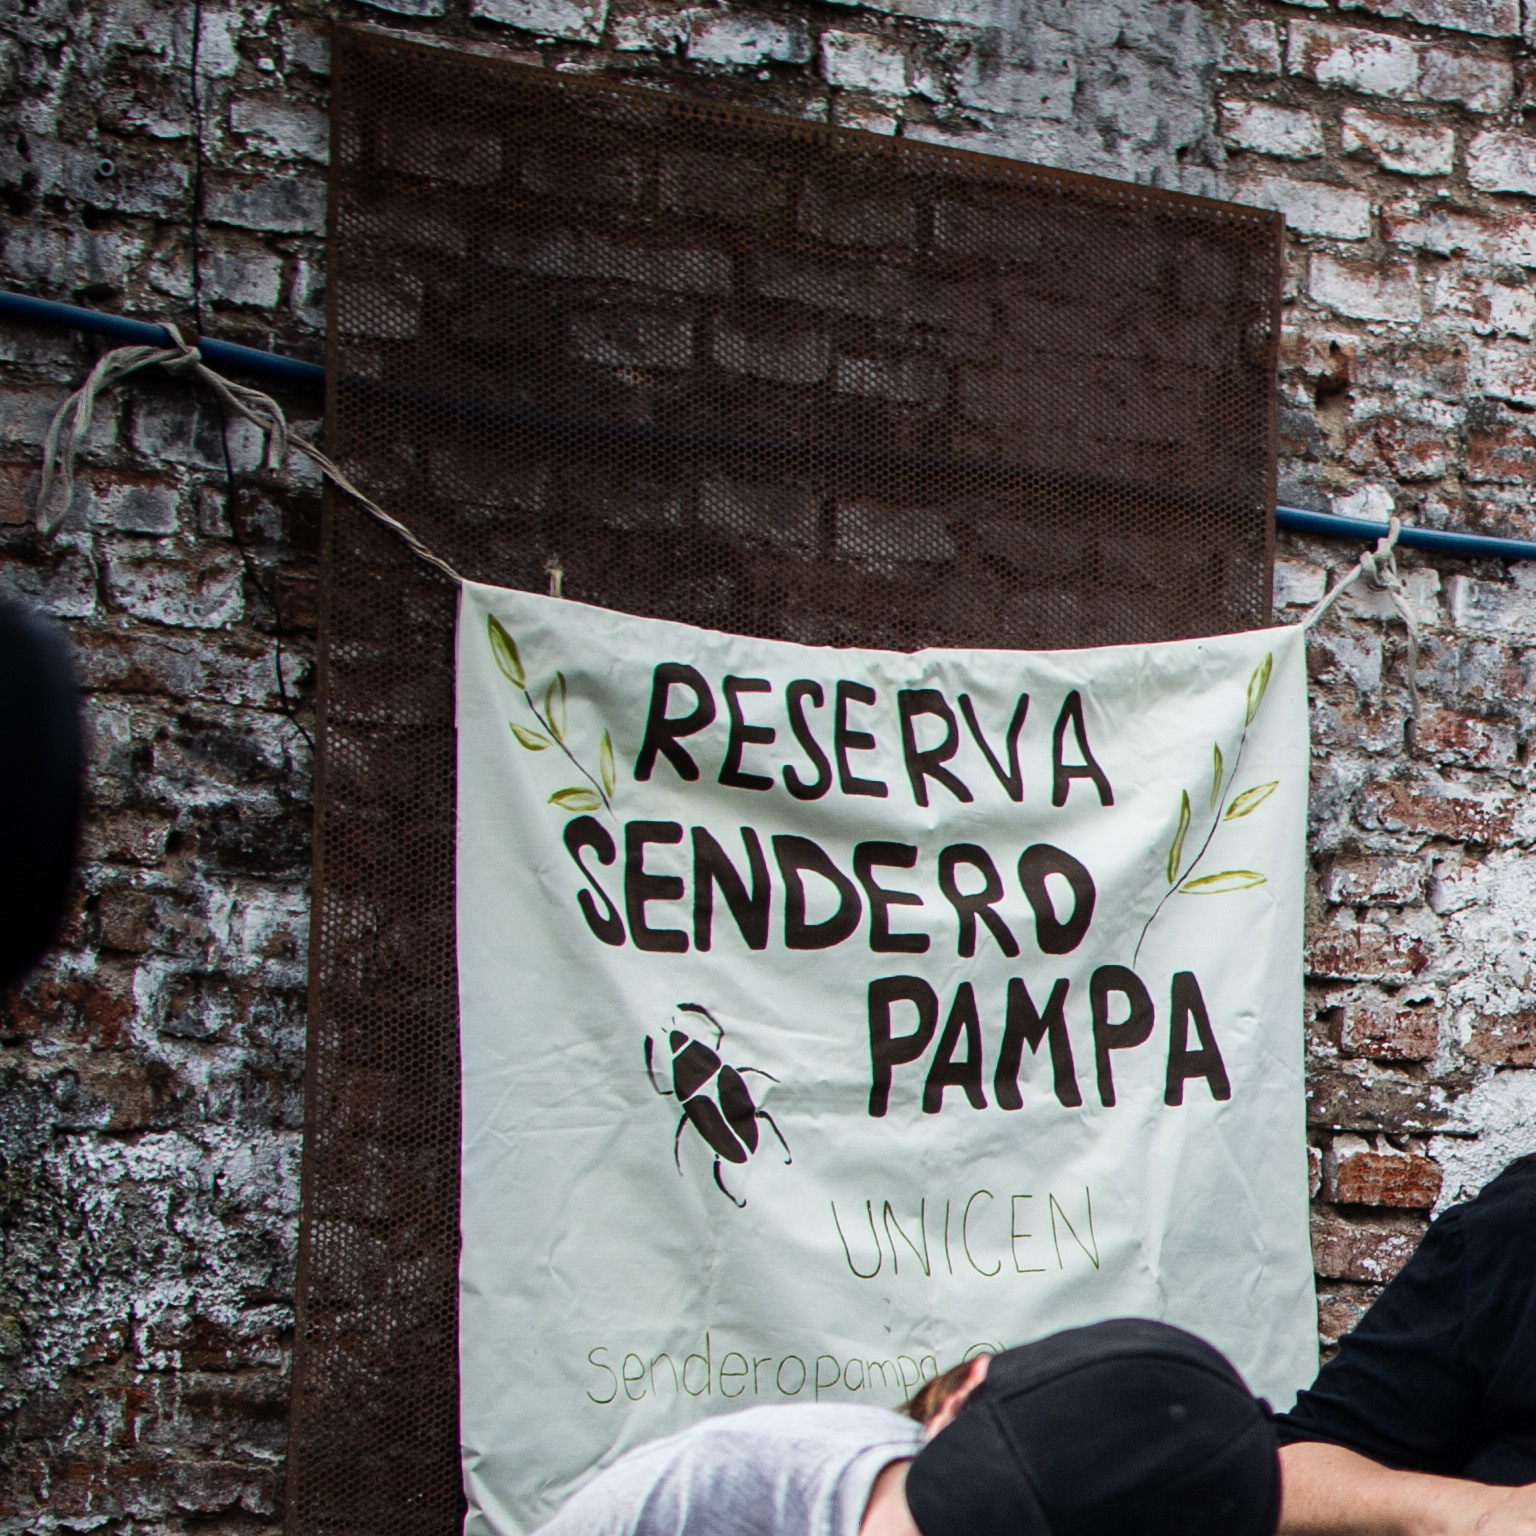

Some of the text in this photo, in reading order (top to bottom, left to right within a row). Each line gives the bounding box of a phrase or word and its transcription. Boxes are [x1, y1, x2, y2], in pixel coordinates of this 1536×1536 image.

[633, 662, 1114, 807] RESERVA
[562, 815, 1096, 958] SENDERO
[867, 964, 1231, 1117] PAMPA
[831, 1186, 1102, 1278] UNICEN
